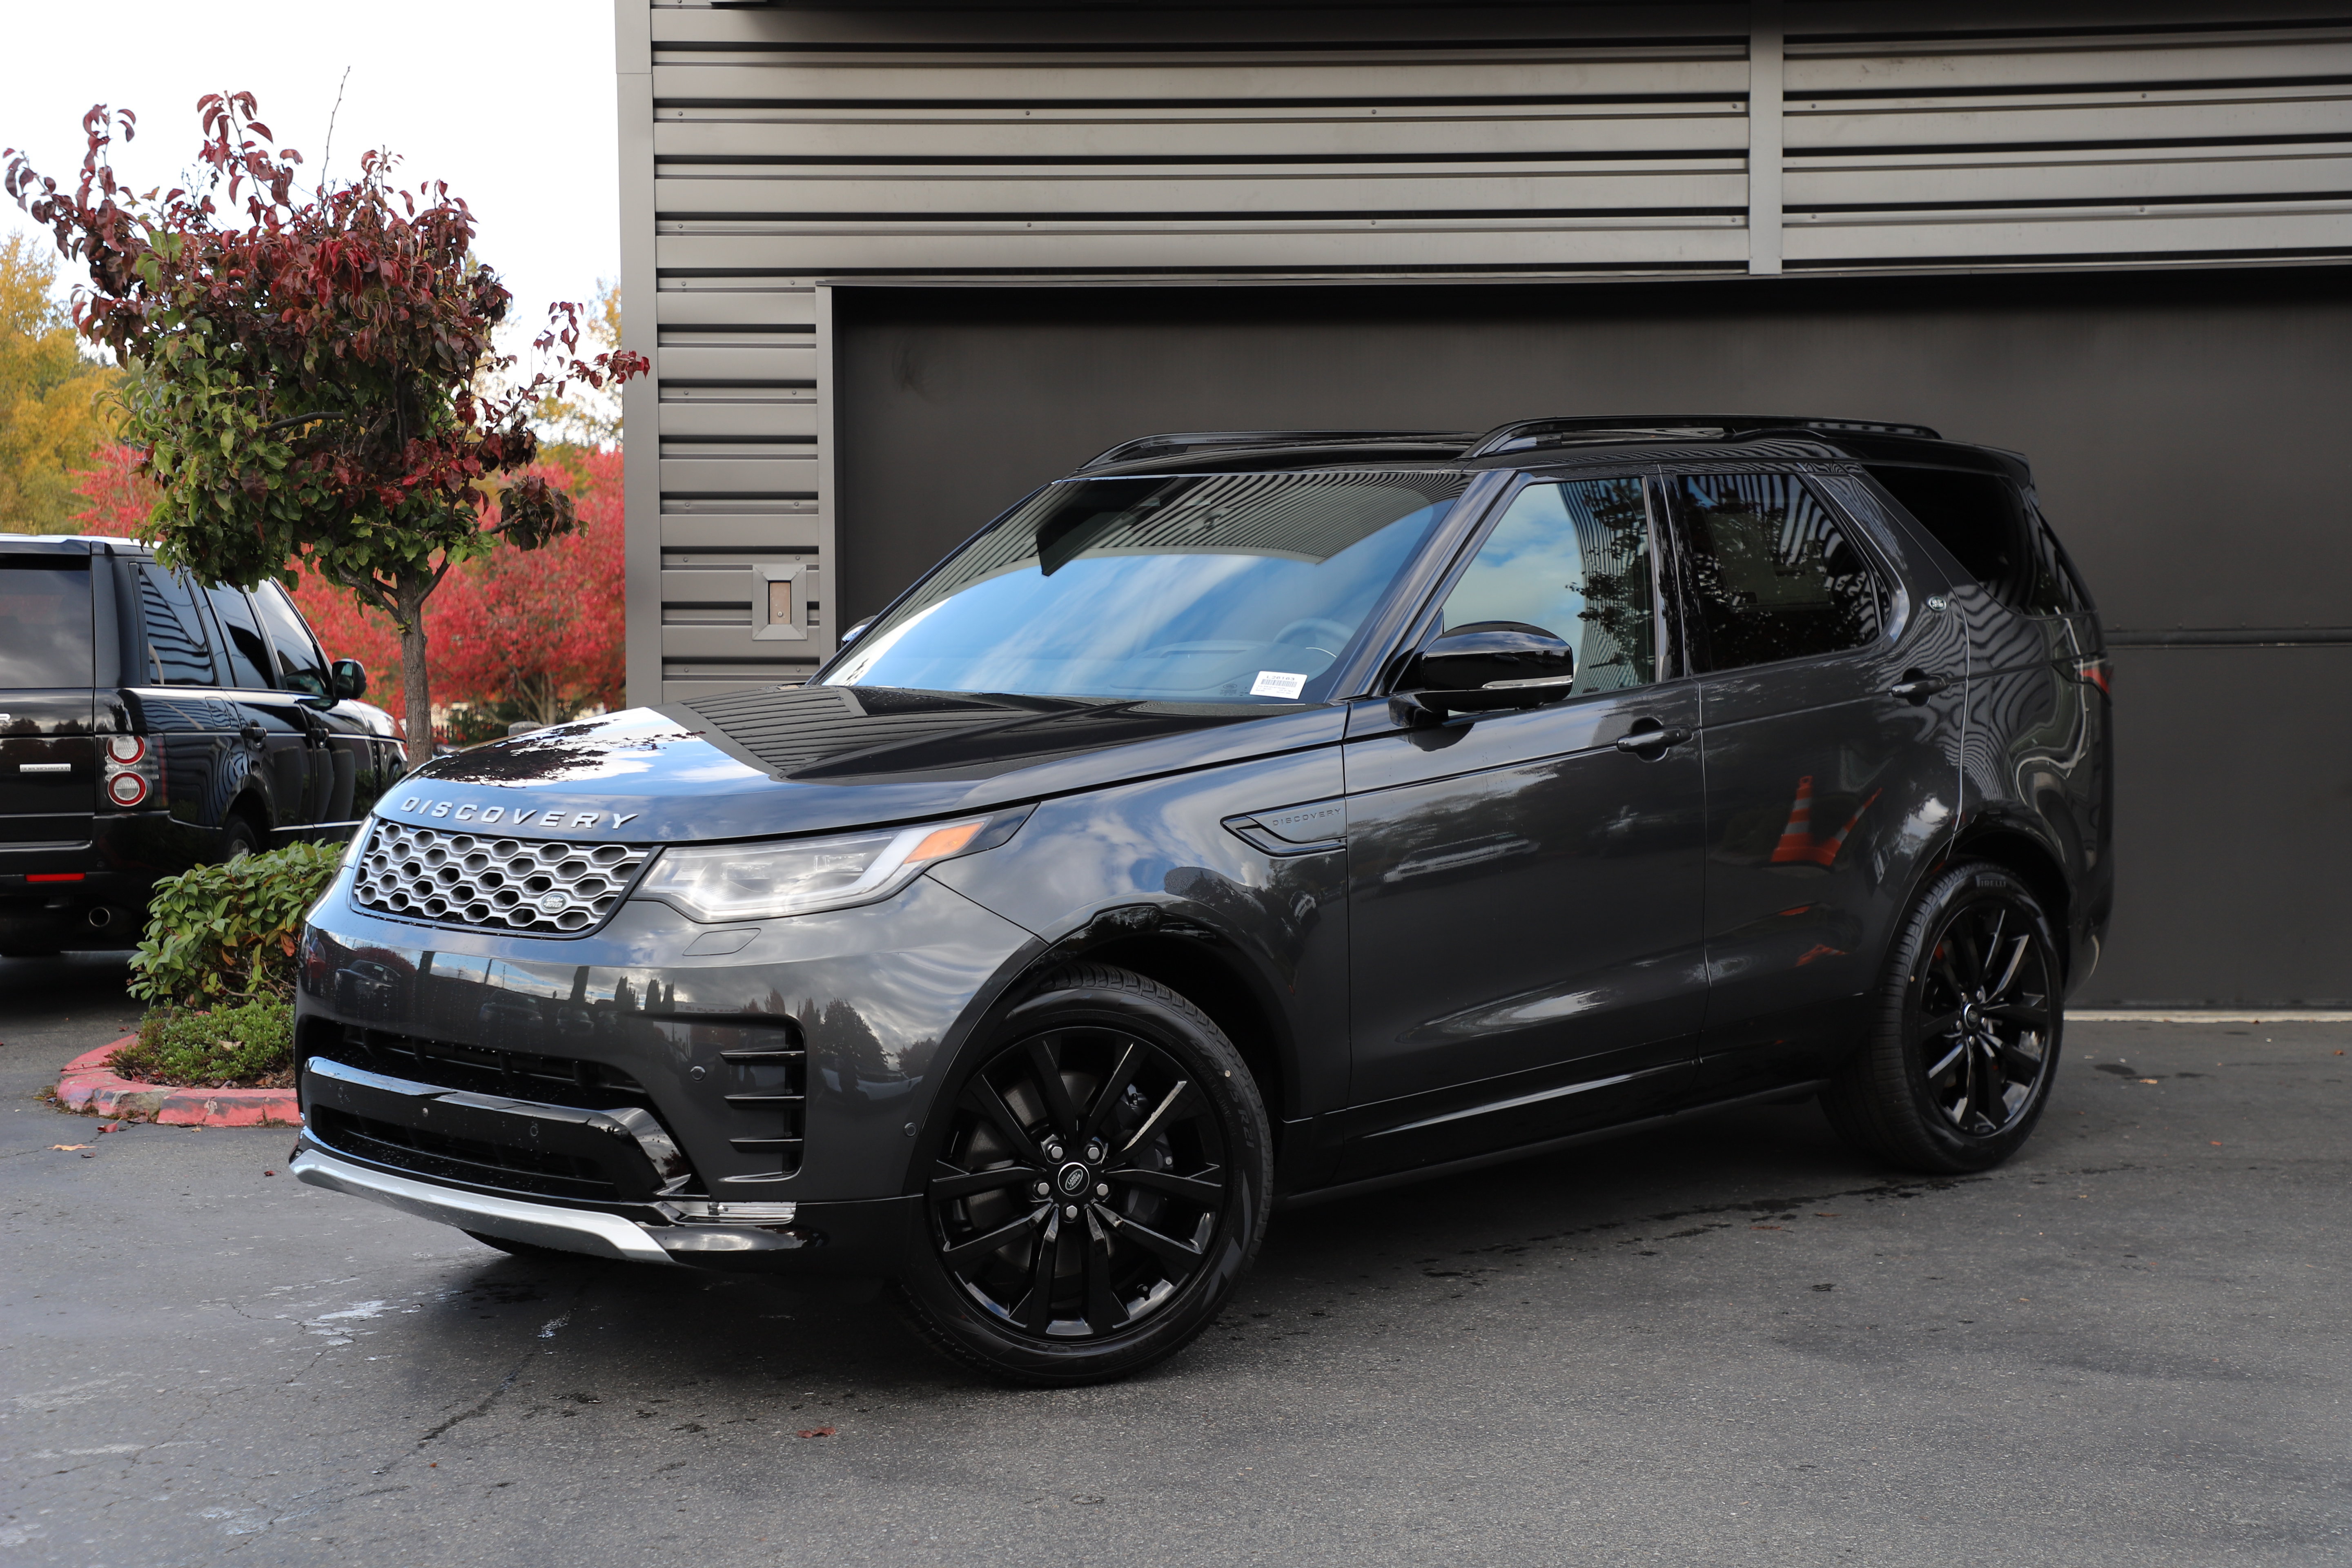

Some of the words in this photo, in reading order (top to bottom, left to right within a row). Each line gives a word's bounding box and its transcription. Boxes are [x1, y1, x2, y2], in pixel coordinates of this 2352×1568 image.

[400, 797, 639, 829] DISCOVERY
[1272, 808, 1341, 826] DISCOVERY
[1975, 872, 2006, 887] PIRELLI
[1238, 1109, 1255, 1148] R21
[1068, 1174, 1077, 1185] LAND
[1071, 1173, 1081, 1187] ROVER
